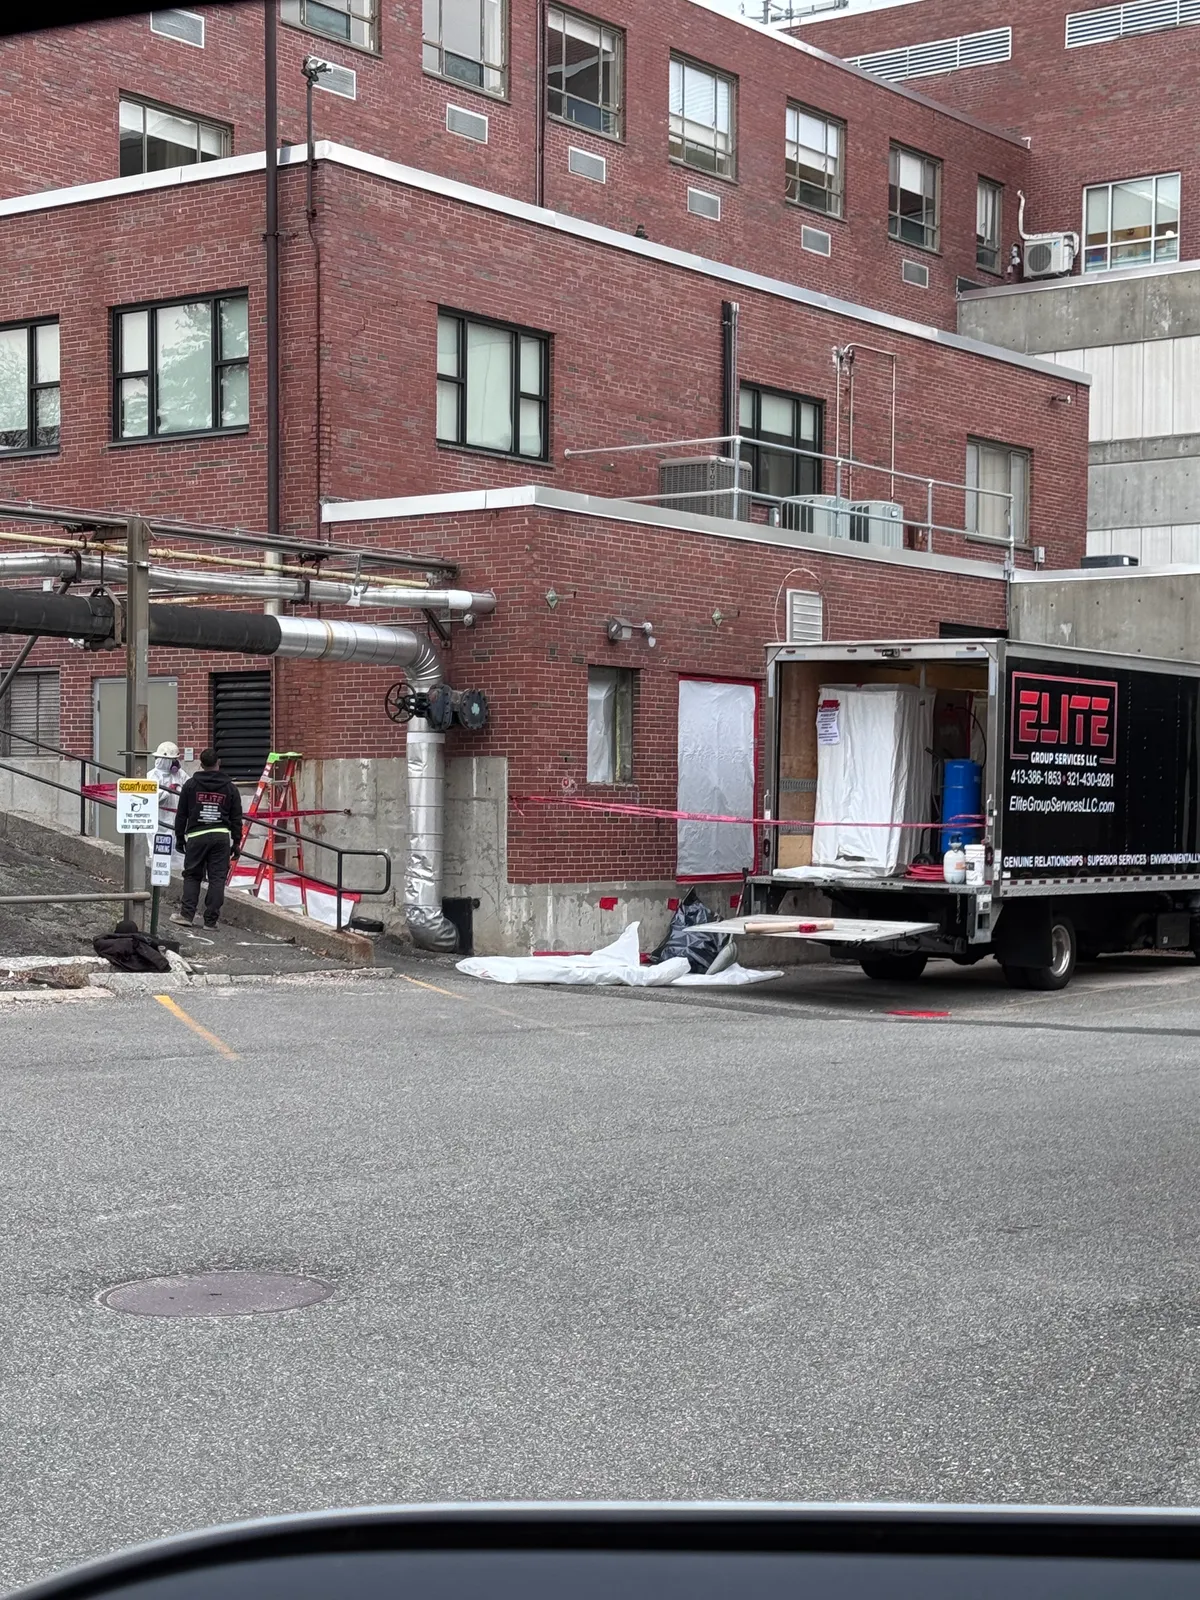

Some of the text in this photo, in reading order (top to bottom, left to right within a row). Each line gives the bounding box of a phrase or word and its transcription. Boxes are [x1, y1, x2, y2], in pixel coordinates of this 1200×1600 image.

[1019, 690, 1110, 746] ELITE
[1030, 751, 1098, 767] GROUP SERVICES LLC
[1010, 769, 1114, 787] 413-386-1853 321-430-9281
[119, 782, 157, 791] SECURITY NOTICE
[198, 793, 223, 802] ELITE
[1009, 795, 1115, 815] EliteGroupServicesLLC.com
[1003, 856, 1034, 868] GENUINE
[1034, 855, 1083, 867] RELATIONSHIPS
[1087, 854, 1118, 866] SUPERIOR
[1118, 854, 1147, 866] SERVICES
